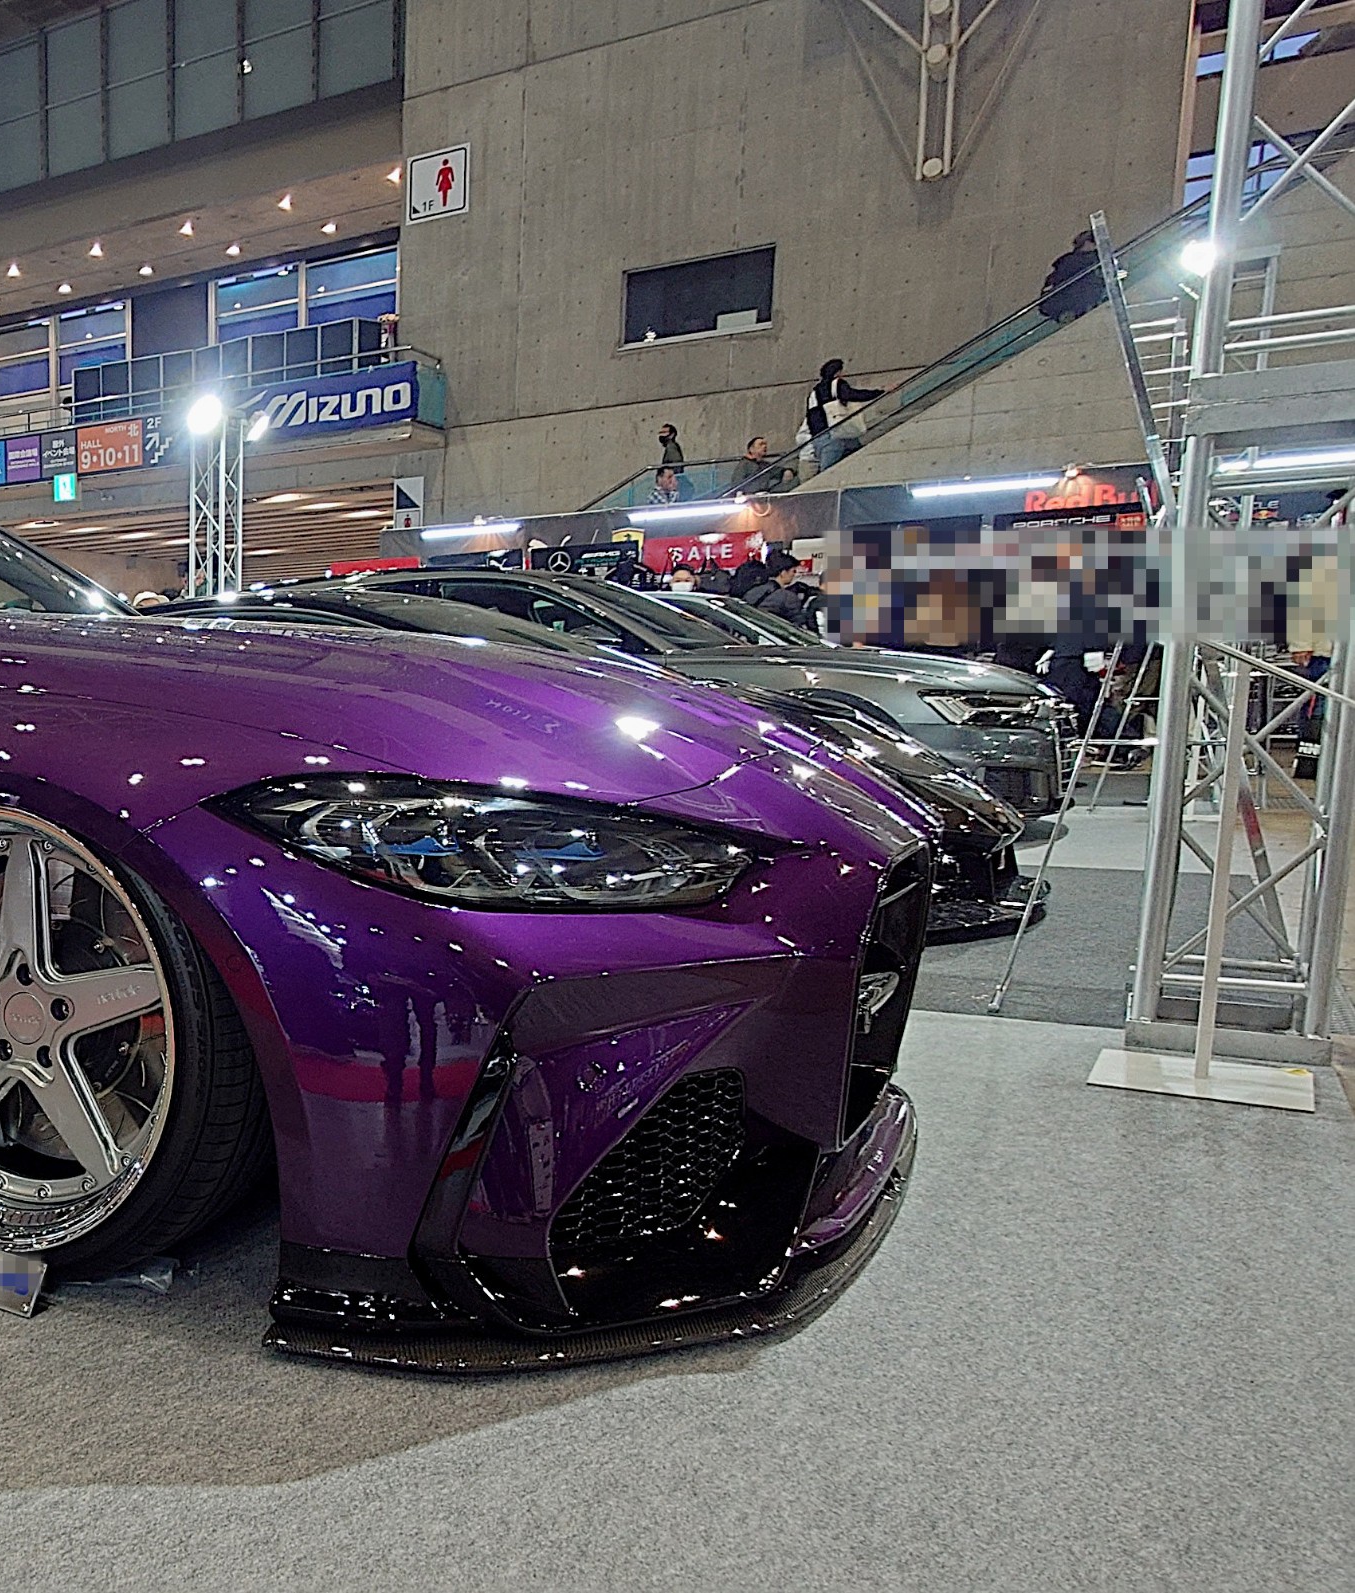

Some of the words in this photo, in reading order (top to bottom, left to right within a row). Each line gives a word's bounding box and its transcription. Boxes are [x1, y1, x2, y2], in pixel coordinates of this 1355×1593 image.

[422, 200, 434, 212] 1F
[267, 381, 411, 428] MIZUNO
[147, 416, 161, 429] 2F
[105, 425, 126, 434] NORTH
[128, 423, 139, 437] 北
[80, 439, 102, 449] HALL
[670, 543, 734, 562] SALE
